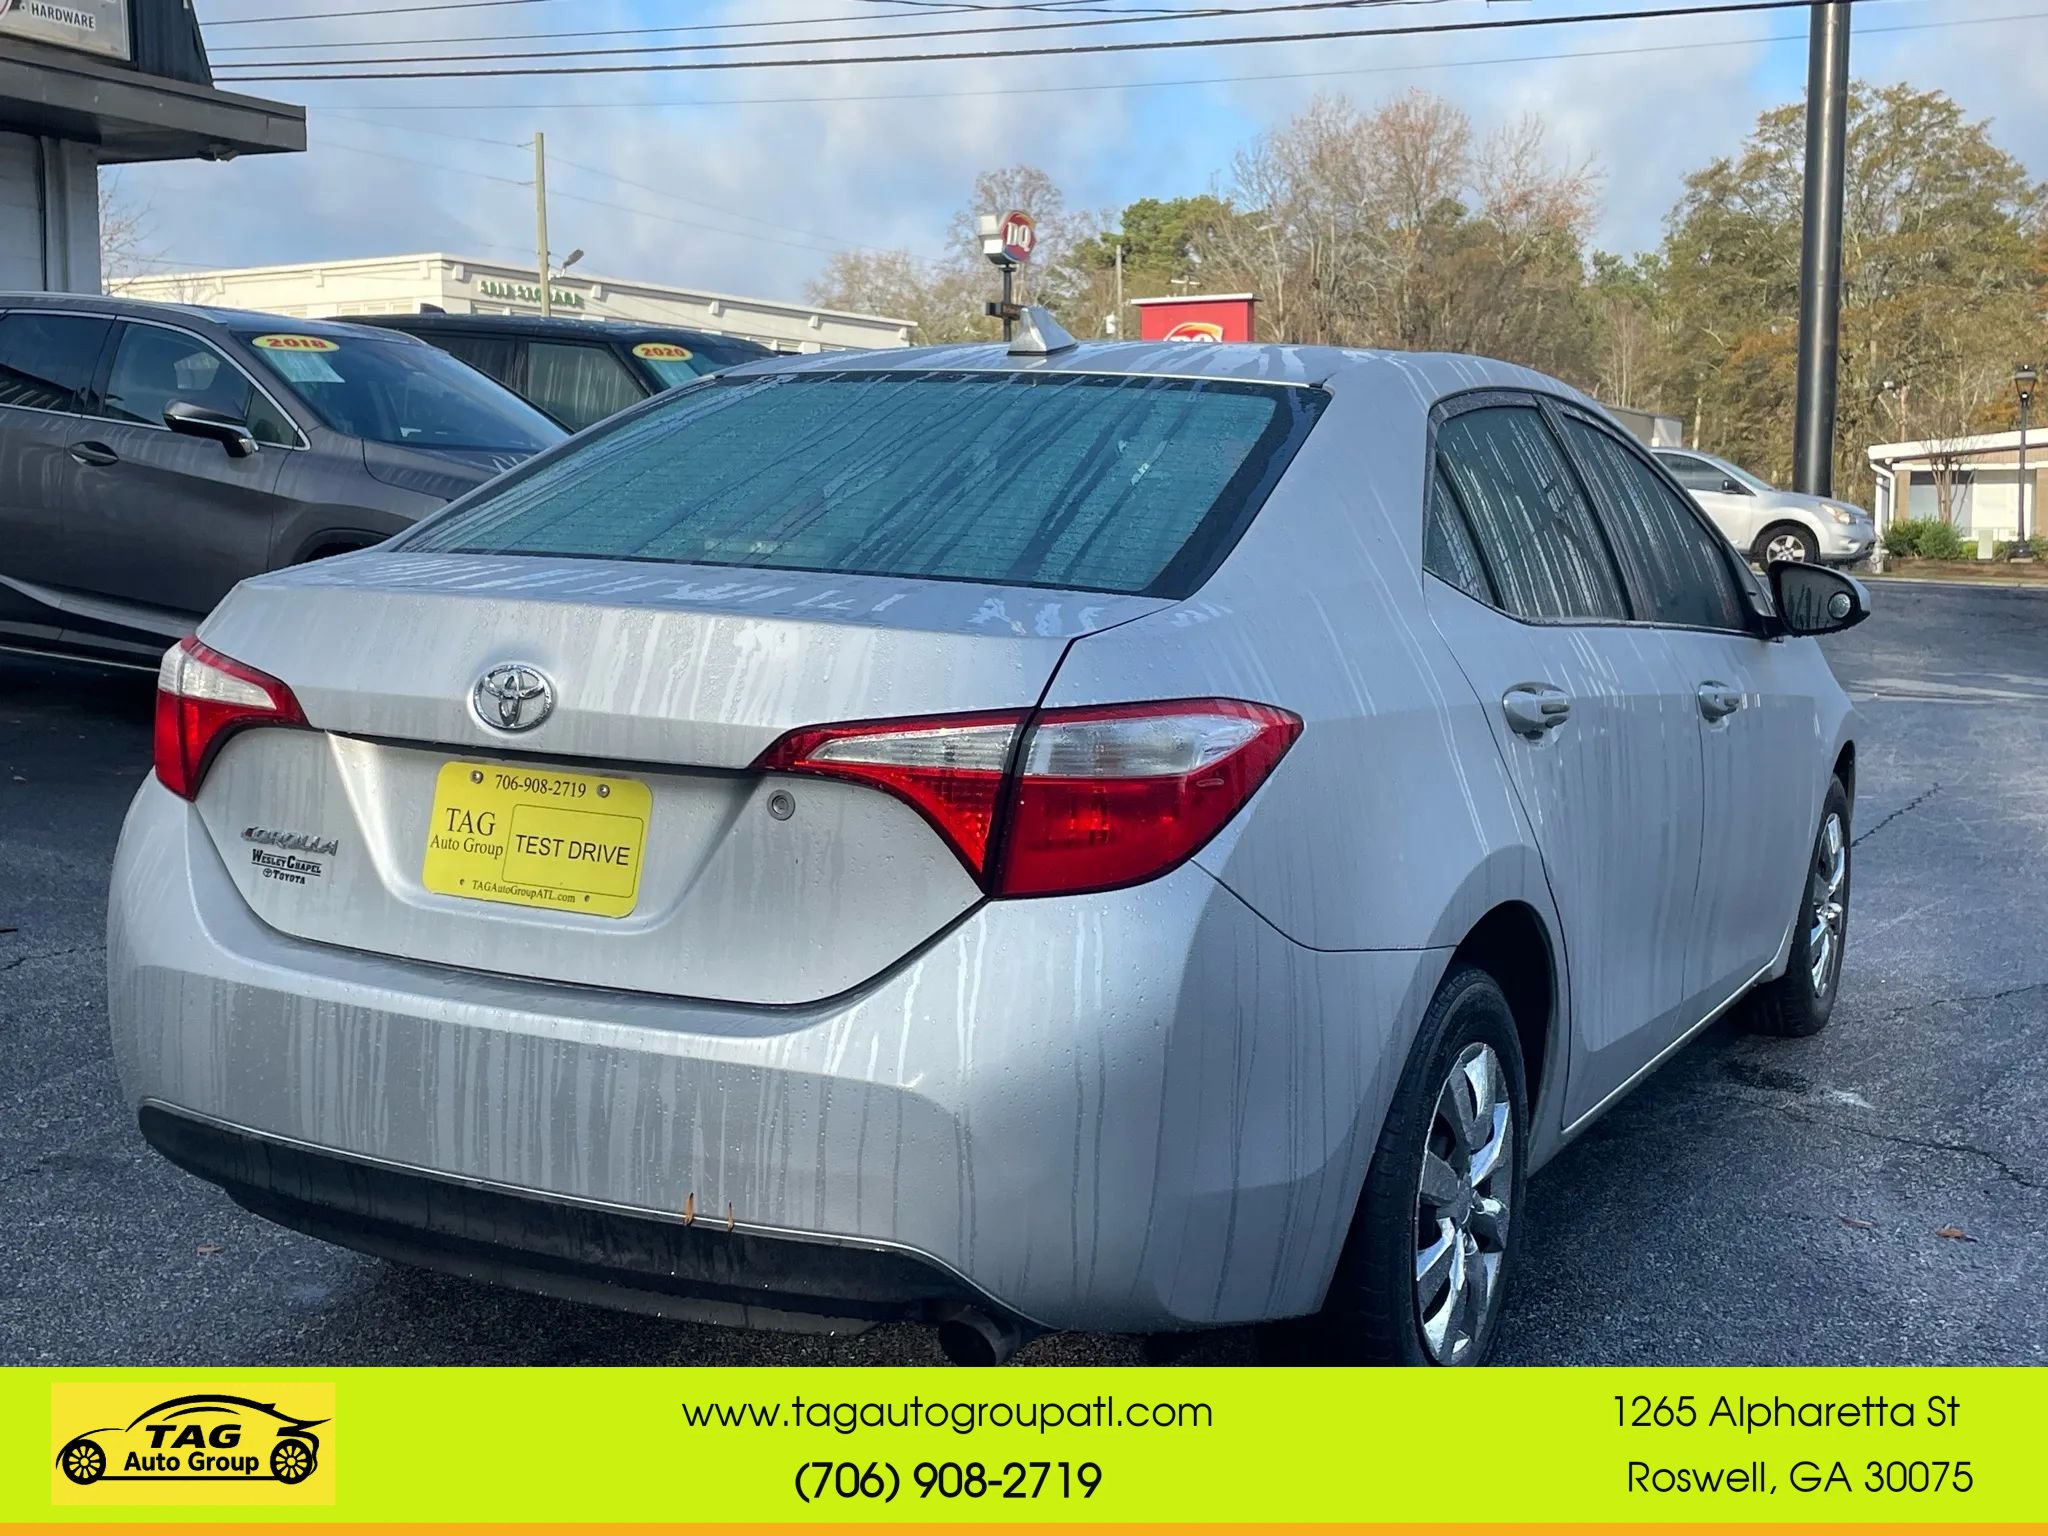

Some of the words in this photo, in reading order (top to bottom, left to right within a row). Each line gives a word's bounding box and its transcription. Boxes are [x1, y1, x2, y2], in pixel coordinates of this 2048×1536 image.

[31, 3, 95, 29] HARDWARE
[1006, 222, 1031, 252] DQ
[266, 338, 328, 349] 2018
[641, 347, 686, 357] 2020
[495, 774, 586, 798] 706-908-2719
[446, 808, 496, 836] TAG
[241, 826, 339, 857] COROLLA
[430, 834, 460, 851] Auto
[463, 837, 504, 860] Group
[515, 834, 564, 858] TEST
[568, 841, 631, 866] DRIVE
[252, 848, 287, 868] WESLEY
[287, 855, 322, 874] CHAPEL
[272, 869, 306, 885] TOYOTA
[472, 880, 576, 903] TAGAutoGroupATL.com
